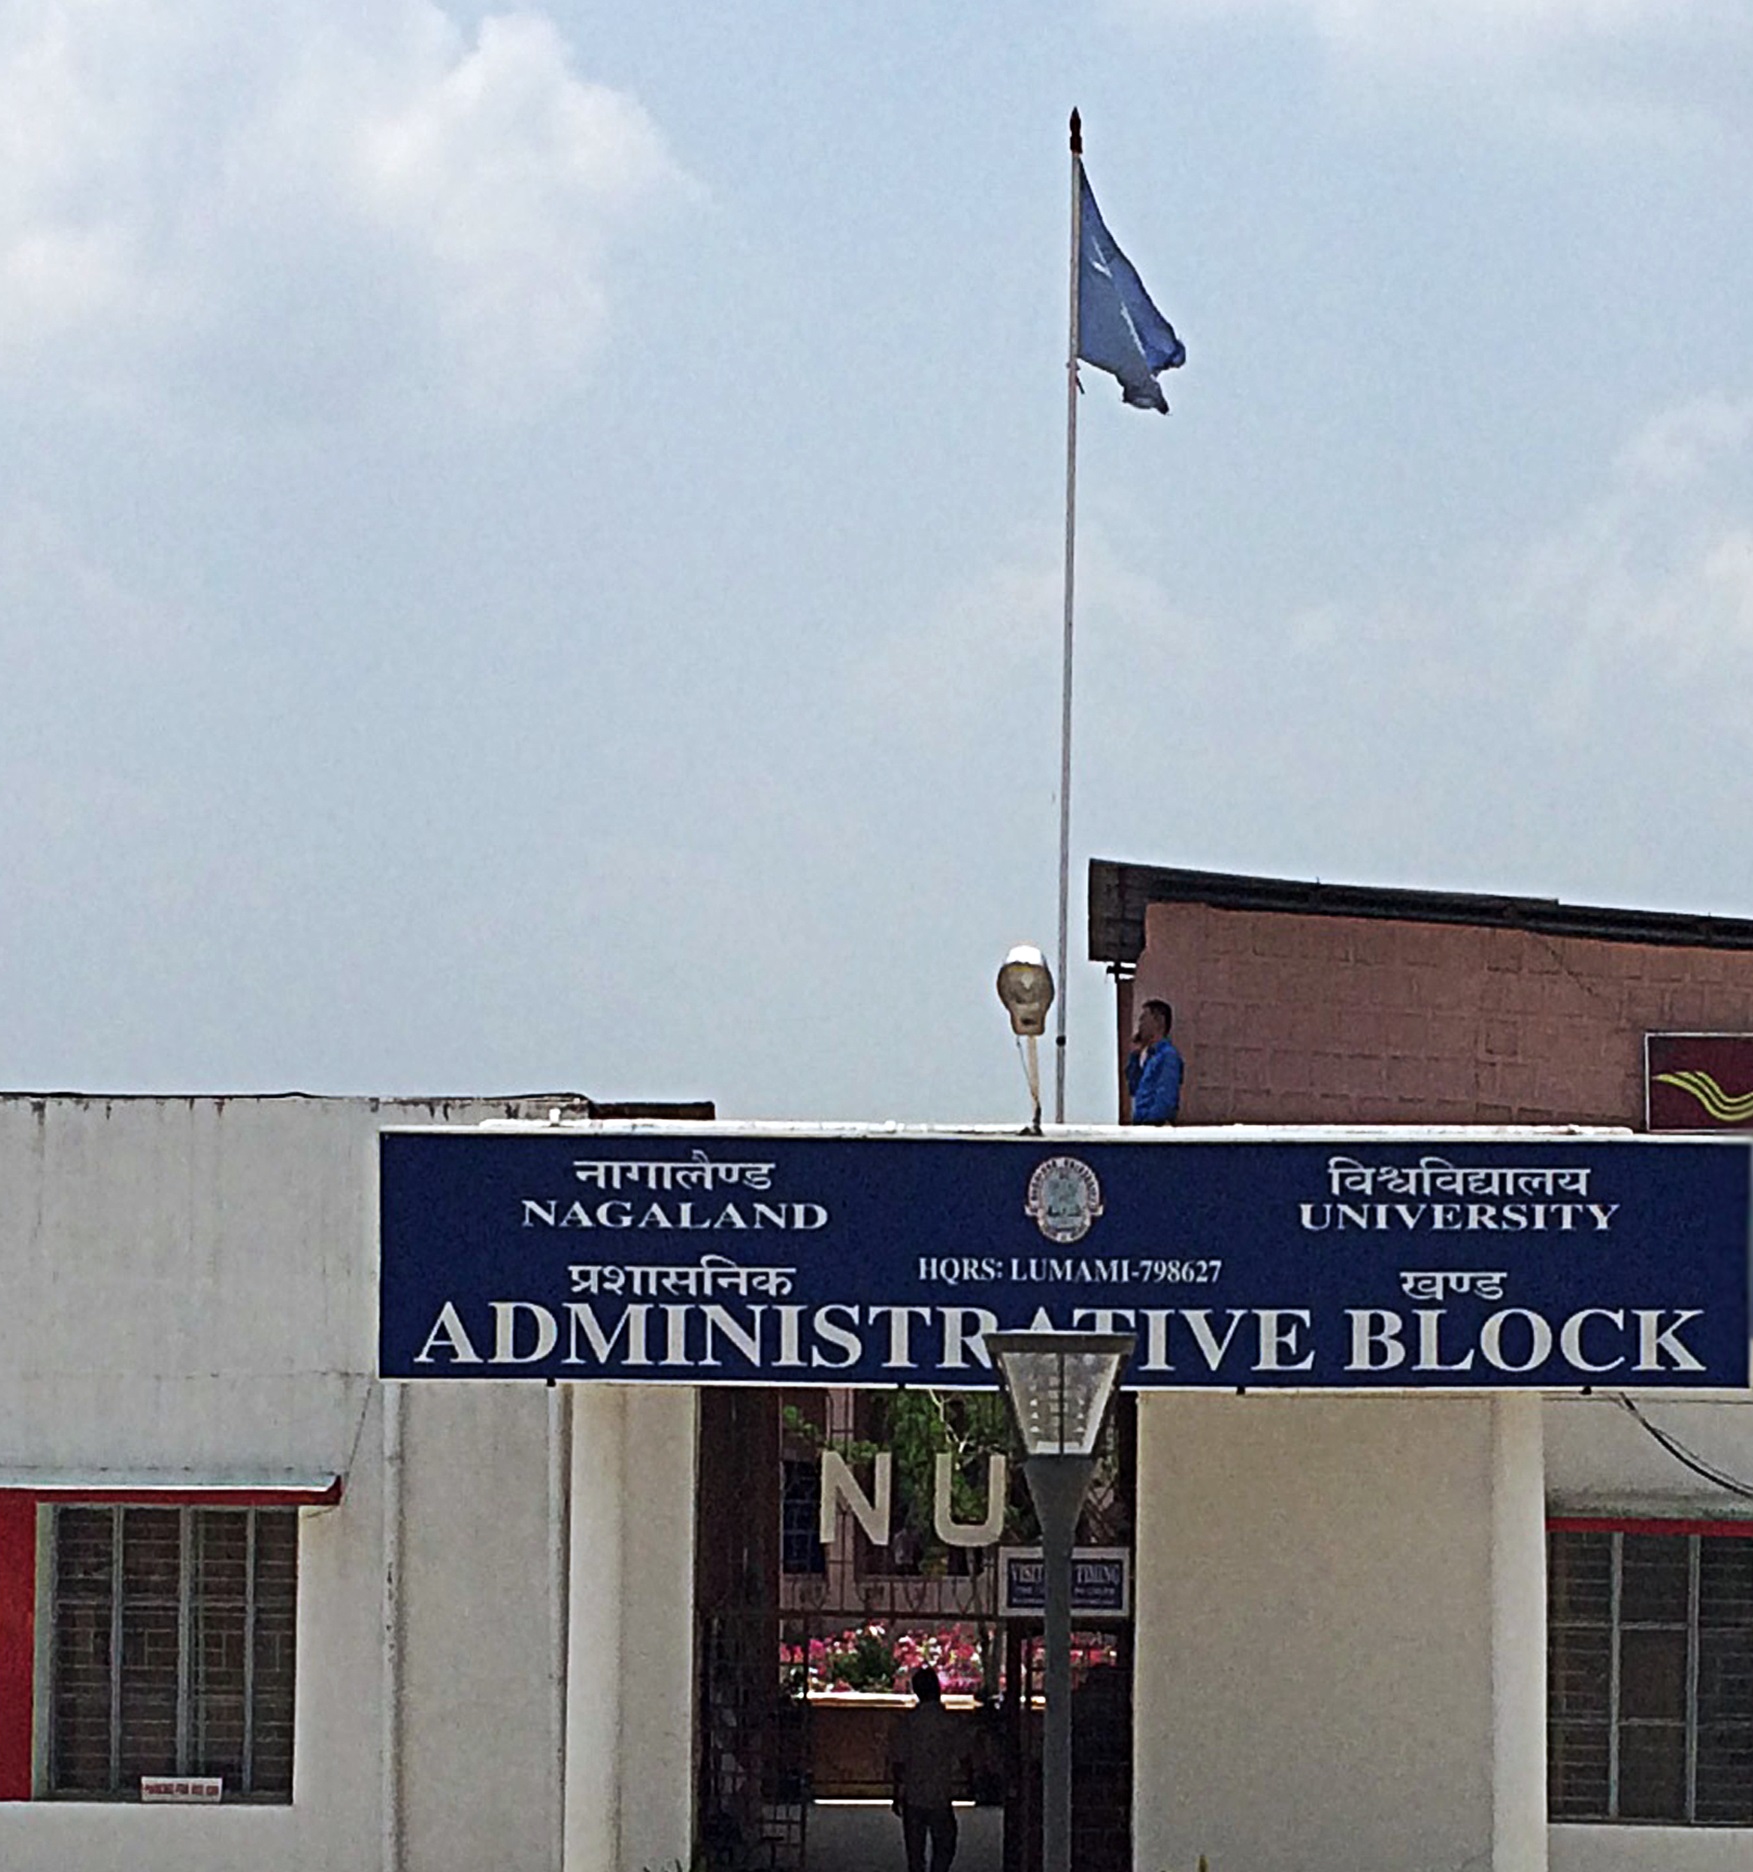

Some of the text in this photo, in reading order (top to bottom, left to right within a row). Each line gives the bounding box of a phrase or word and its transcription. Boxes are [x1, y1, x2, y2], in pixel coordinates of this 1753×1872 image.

[574, 1150, 1592, 1197] नागालैण्ड विश्वविद्यालय
[522, 1200, 1620, 1231] NAGALAND UNIVERSITY
[567, 1254, 1508, 1301] प्रशासनिक खण्ड
[918, 1257, 1223, 1285] HQRS: LUMAMI-798627
[1343, 1308, 1708, 1372] BLOCK
